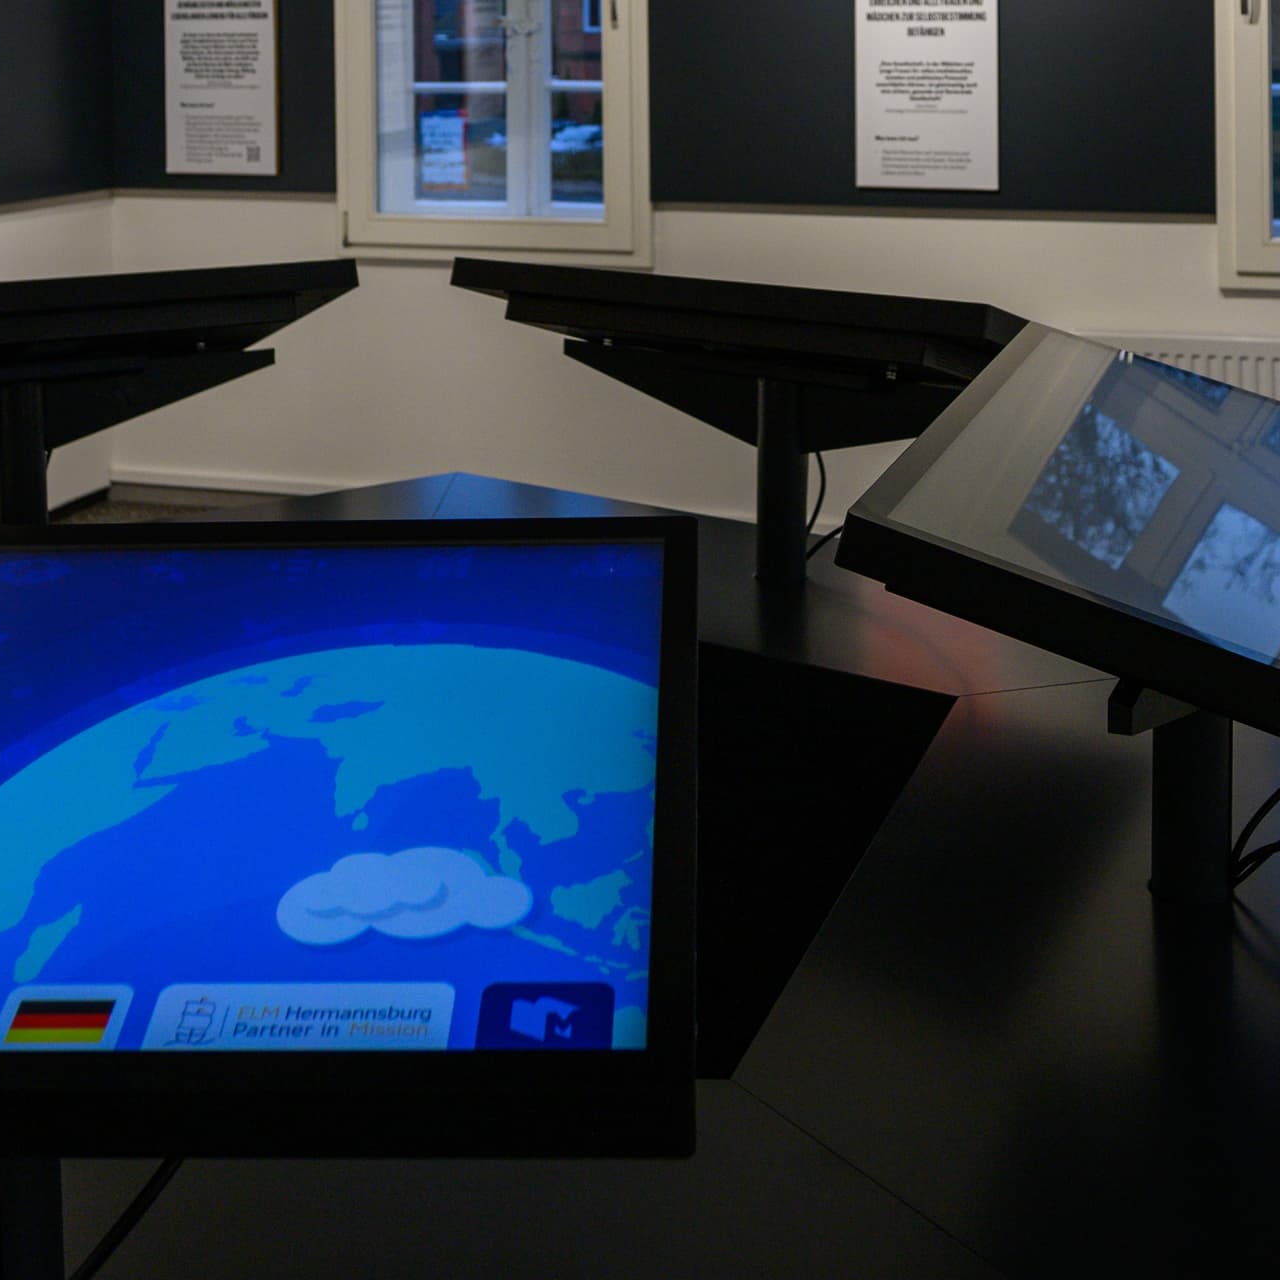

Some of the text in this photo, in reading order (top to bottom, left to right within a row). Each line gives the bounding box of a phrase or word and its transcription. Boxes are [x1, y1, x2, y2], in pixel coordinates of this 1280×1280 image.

[285, 1006, 432, 1023] Hermannsburg
[232, 1022, 430, 1038] Partner in Mission
